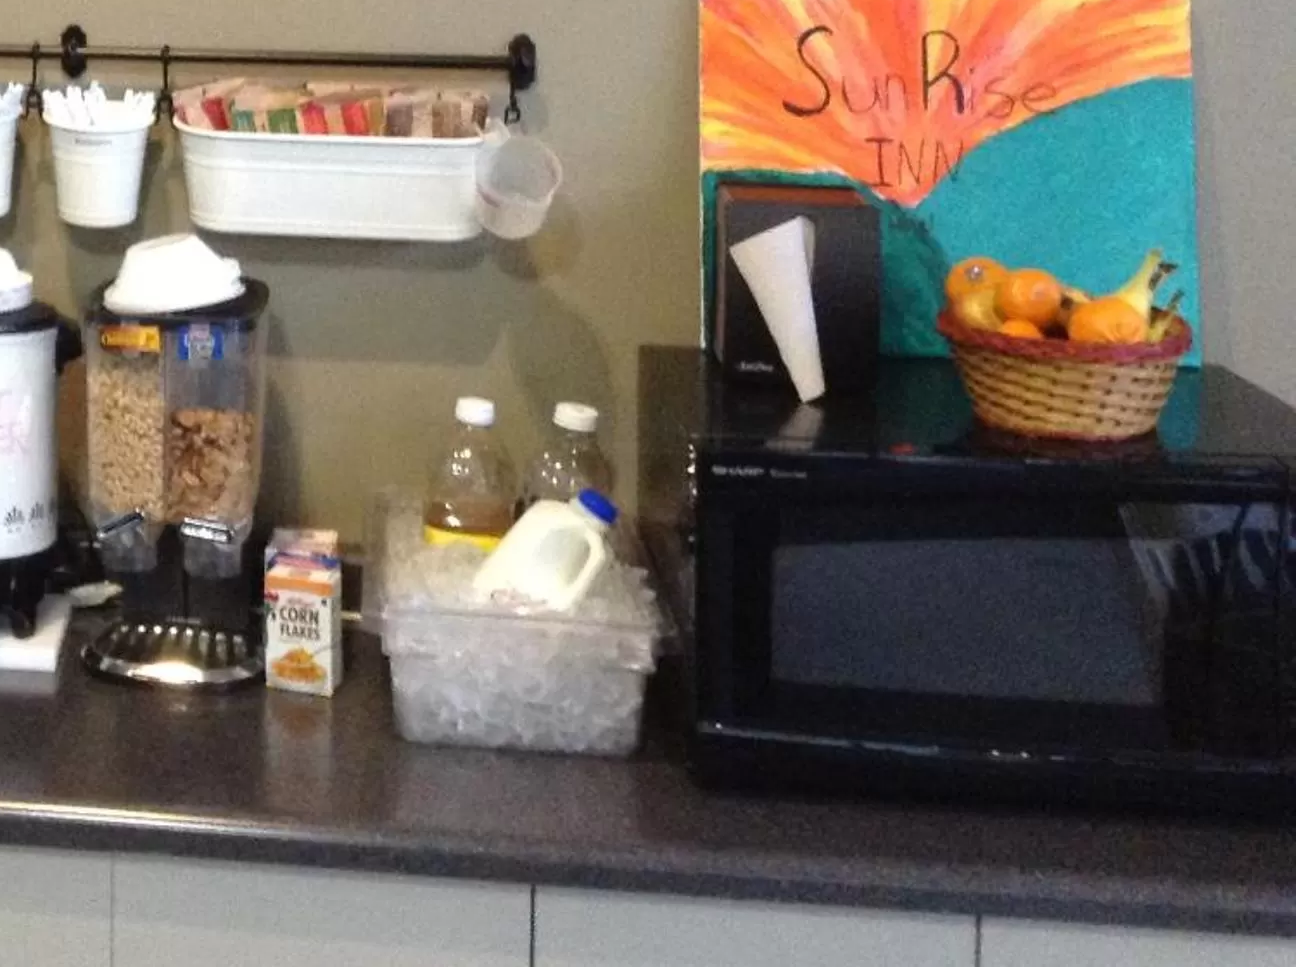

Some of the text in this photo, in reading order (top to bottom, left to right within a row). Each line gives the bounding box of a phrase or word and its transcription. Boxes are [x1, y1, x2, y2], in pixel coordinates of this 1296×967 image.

[864, 137, 966, 188] INN
[279, 606, 320, 626] CORN
[280, 623, 321, 641] FLAKES
